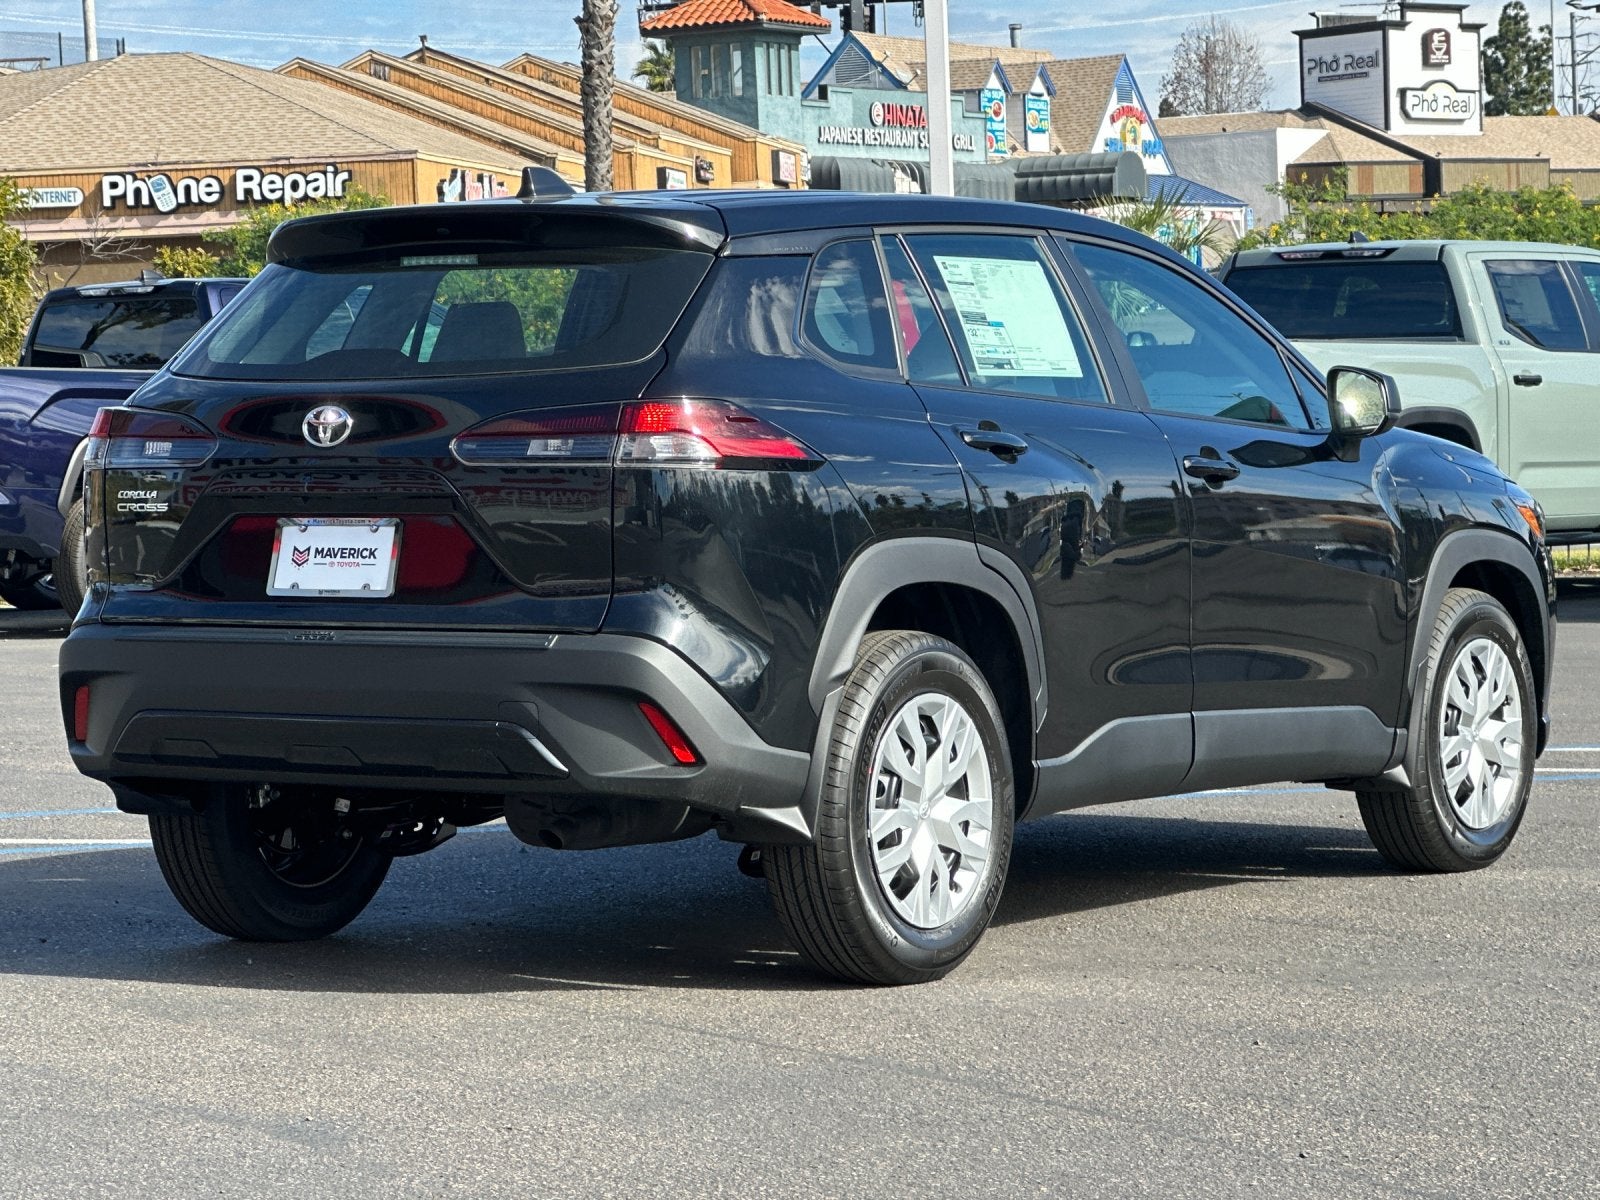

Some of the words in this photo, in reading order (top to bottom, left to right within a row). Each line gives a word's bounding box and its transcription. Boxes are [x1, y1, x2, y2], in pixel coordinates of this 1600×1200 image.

[1345, 50, 1379, 71] Real
[1443, 95, 1470, 113] Real
[883, 102, 928, 128] HINATA
[818, 125, 863, 145] JAPANESE
[863, 127, 919, 149] RESTAURANT
[953, 133, 976, 151] GRILL
[235, 164, 349, 207] Repair
[117, 490, 158, 499] COROLLA
[117, 502, 169, 512] CROSS
[313, 546, 379, 560] MAVERICK
